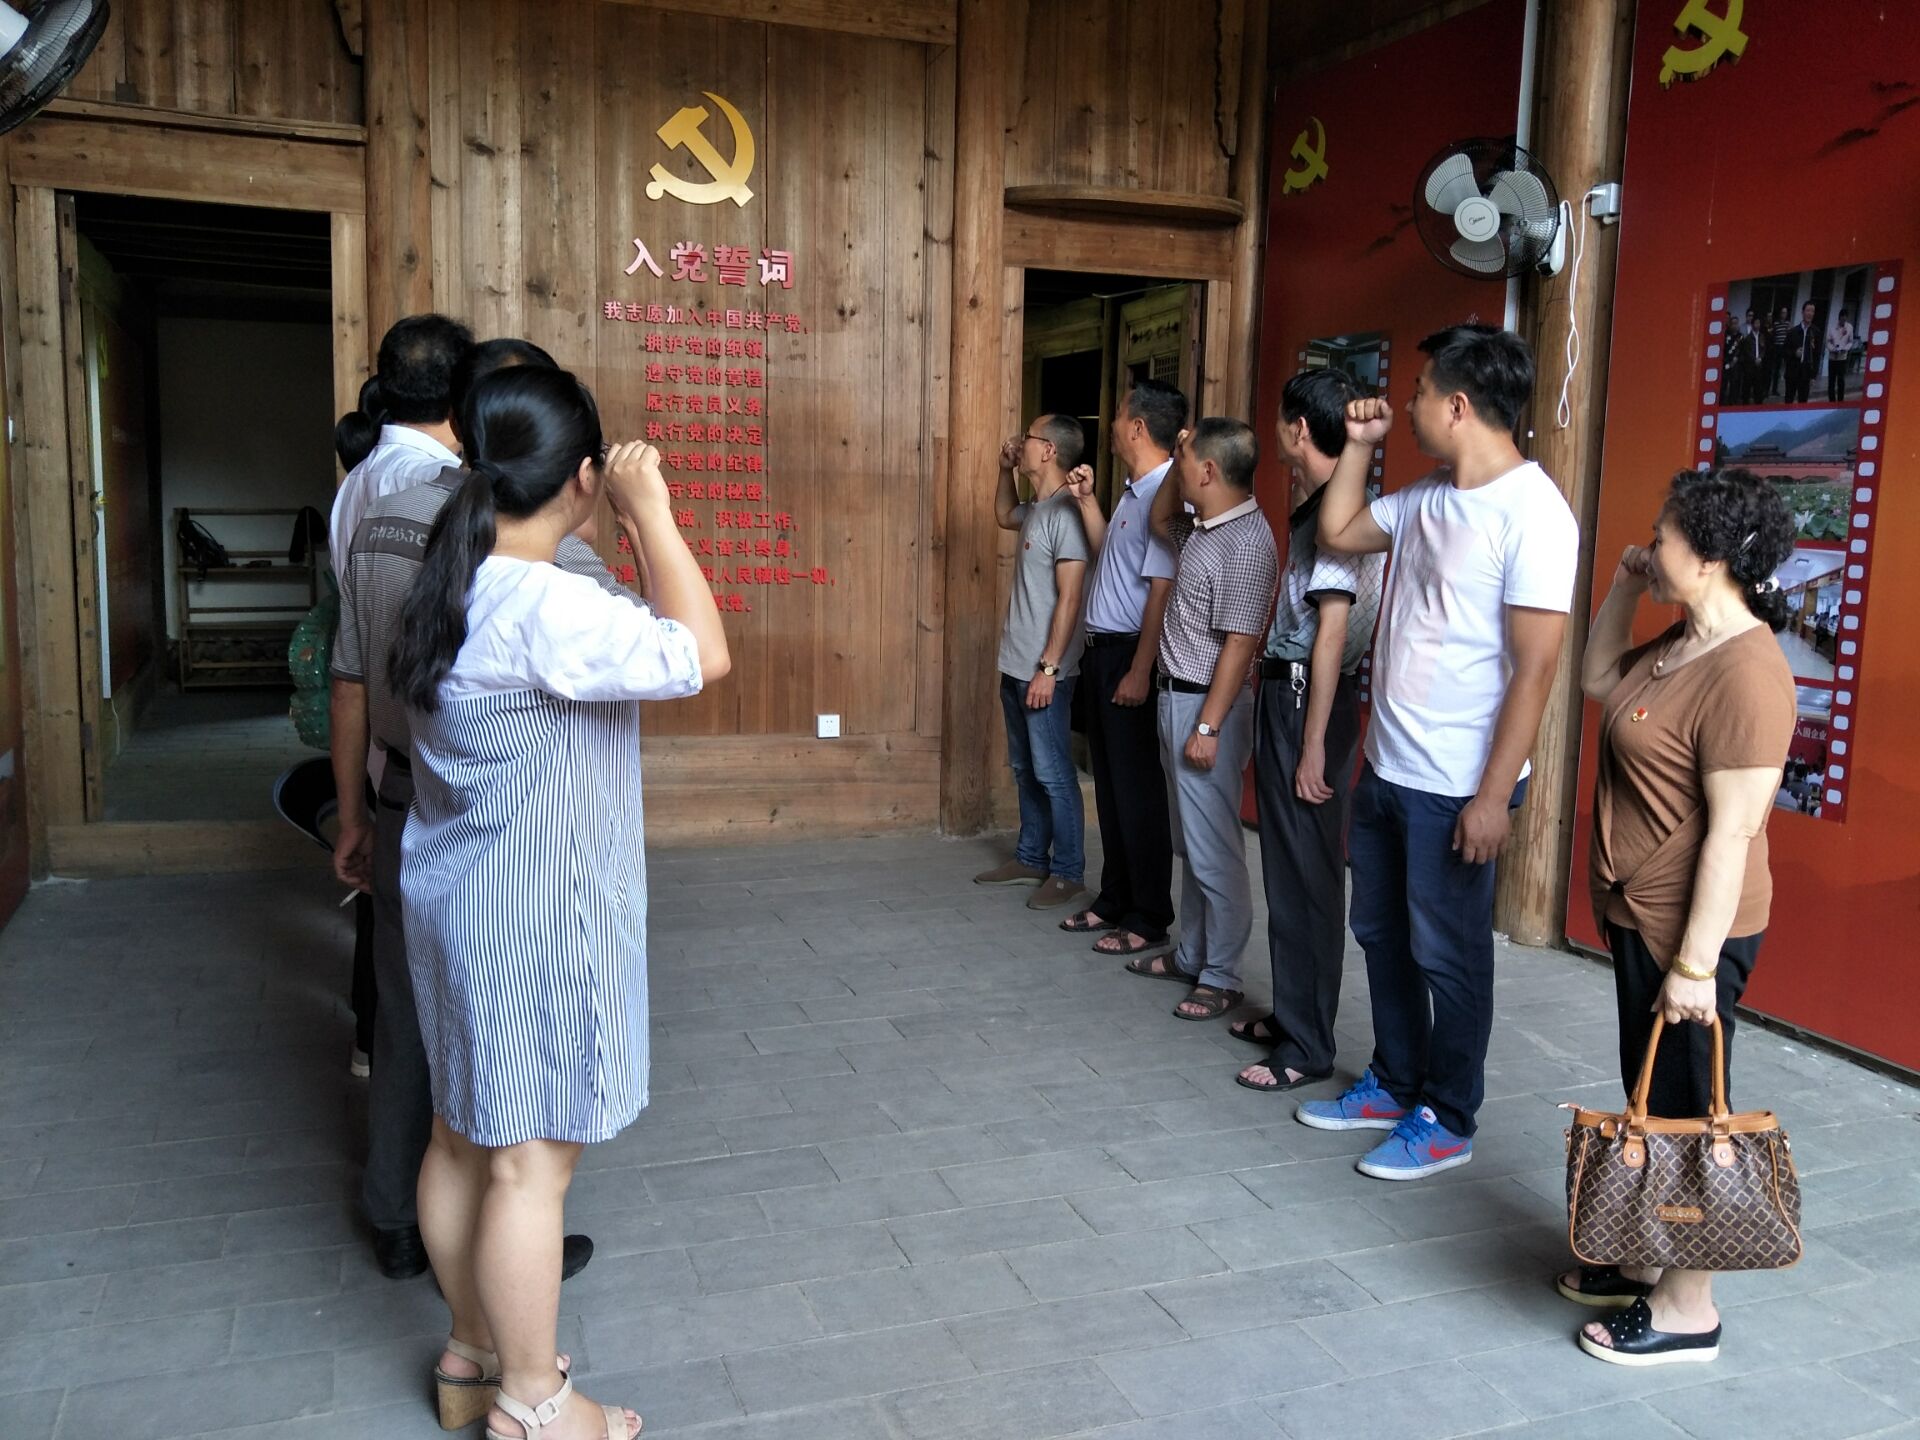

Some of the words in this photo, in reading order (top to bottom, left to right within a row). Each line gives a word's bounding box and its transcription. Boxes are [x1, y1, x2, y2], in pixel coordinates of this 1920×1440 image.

[624, 237, 795, 289] 入党誓词
[659, 450, 771, 474] 守党的纪律，
